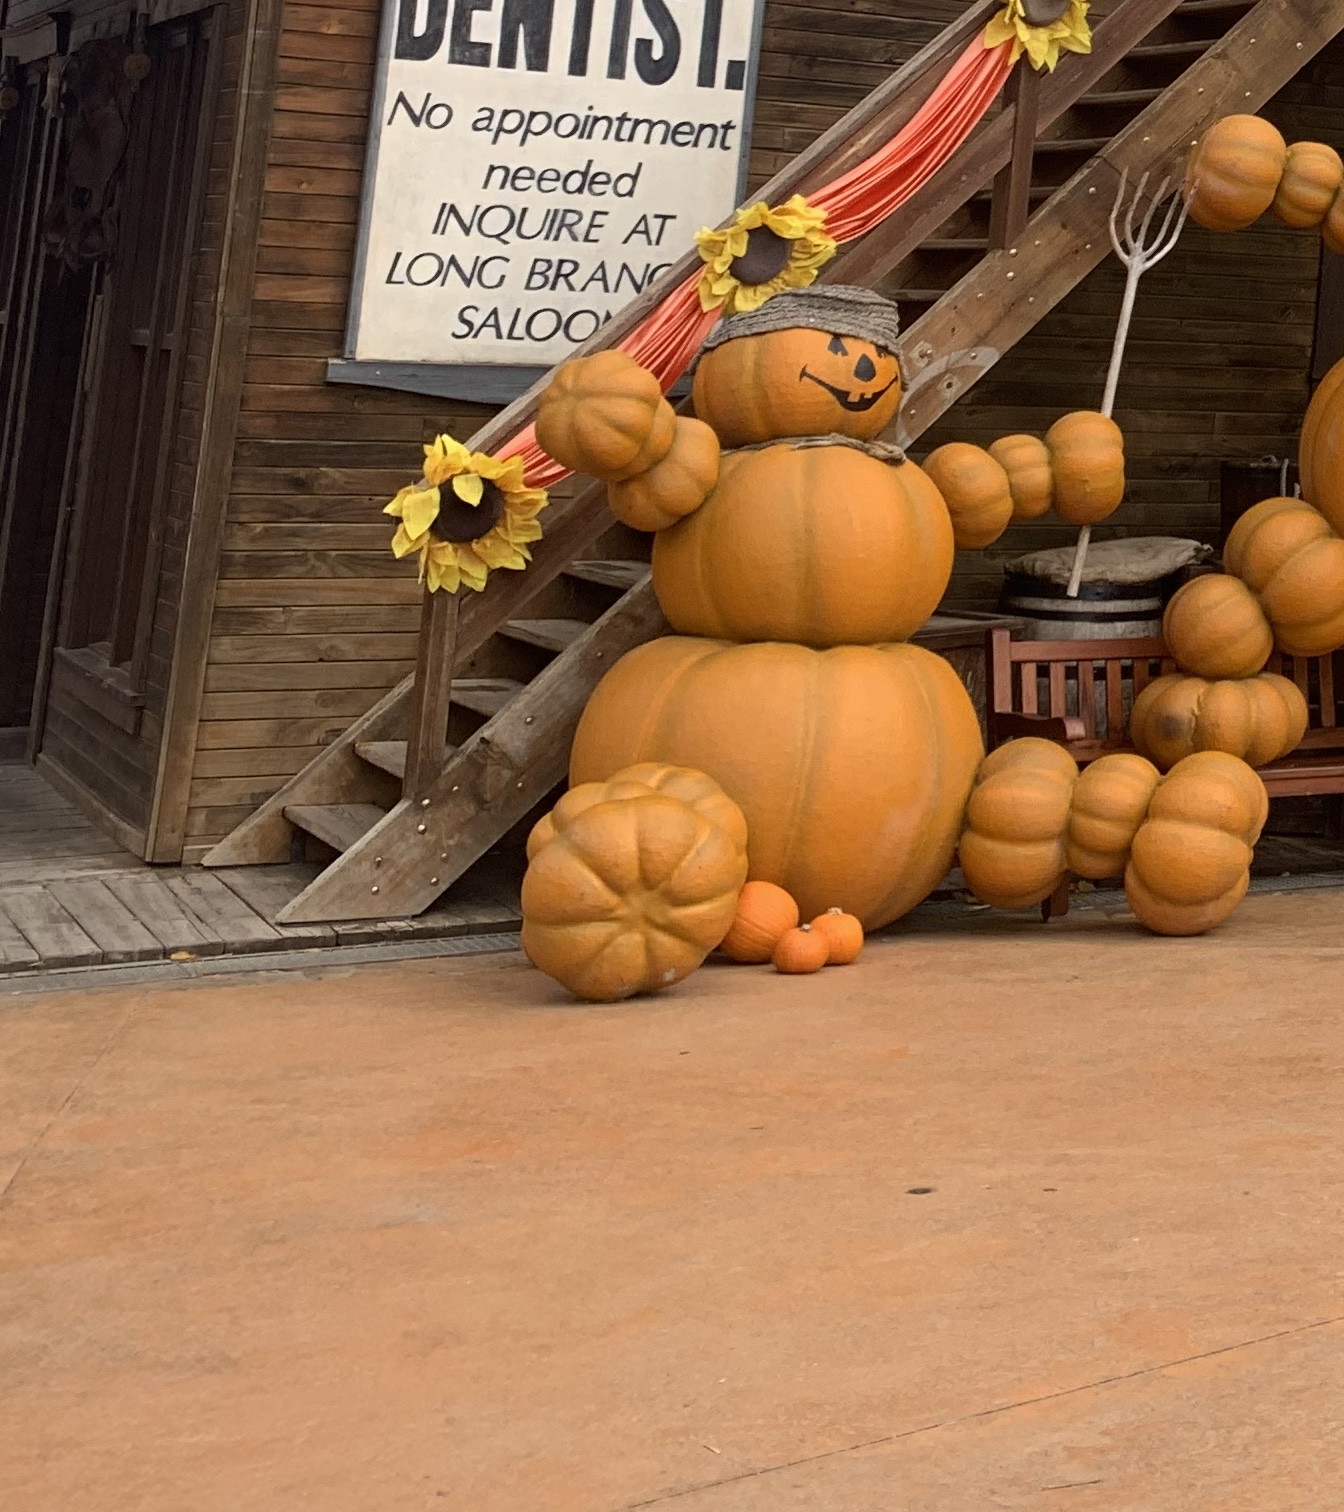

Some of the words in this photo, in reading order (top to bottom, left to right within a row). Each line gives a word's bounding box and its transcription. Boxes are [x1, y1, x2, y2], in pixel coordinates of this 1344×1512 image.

[387, 91, 453, 130] No
[471, 104, 736, 152] appointment
[482, 159, 643, 198] needed
[432, 201, 609, 244] INQUIRE
[622, 213, 677, 247] AT
[385, 251, 510, 289] LONG
[524, 257, 673, 295] BRANC
[451, 304, 613, 344] SALOO
